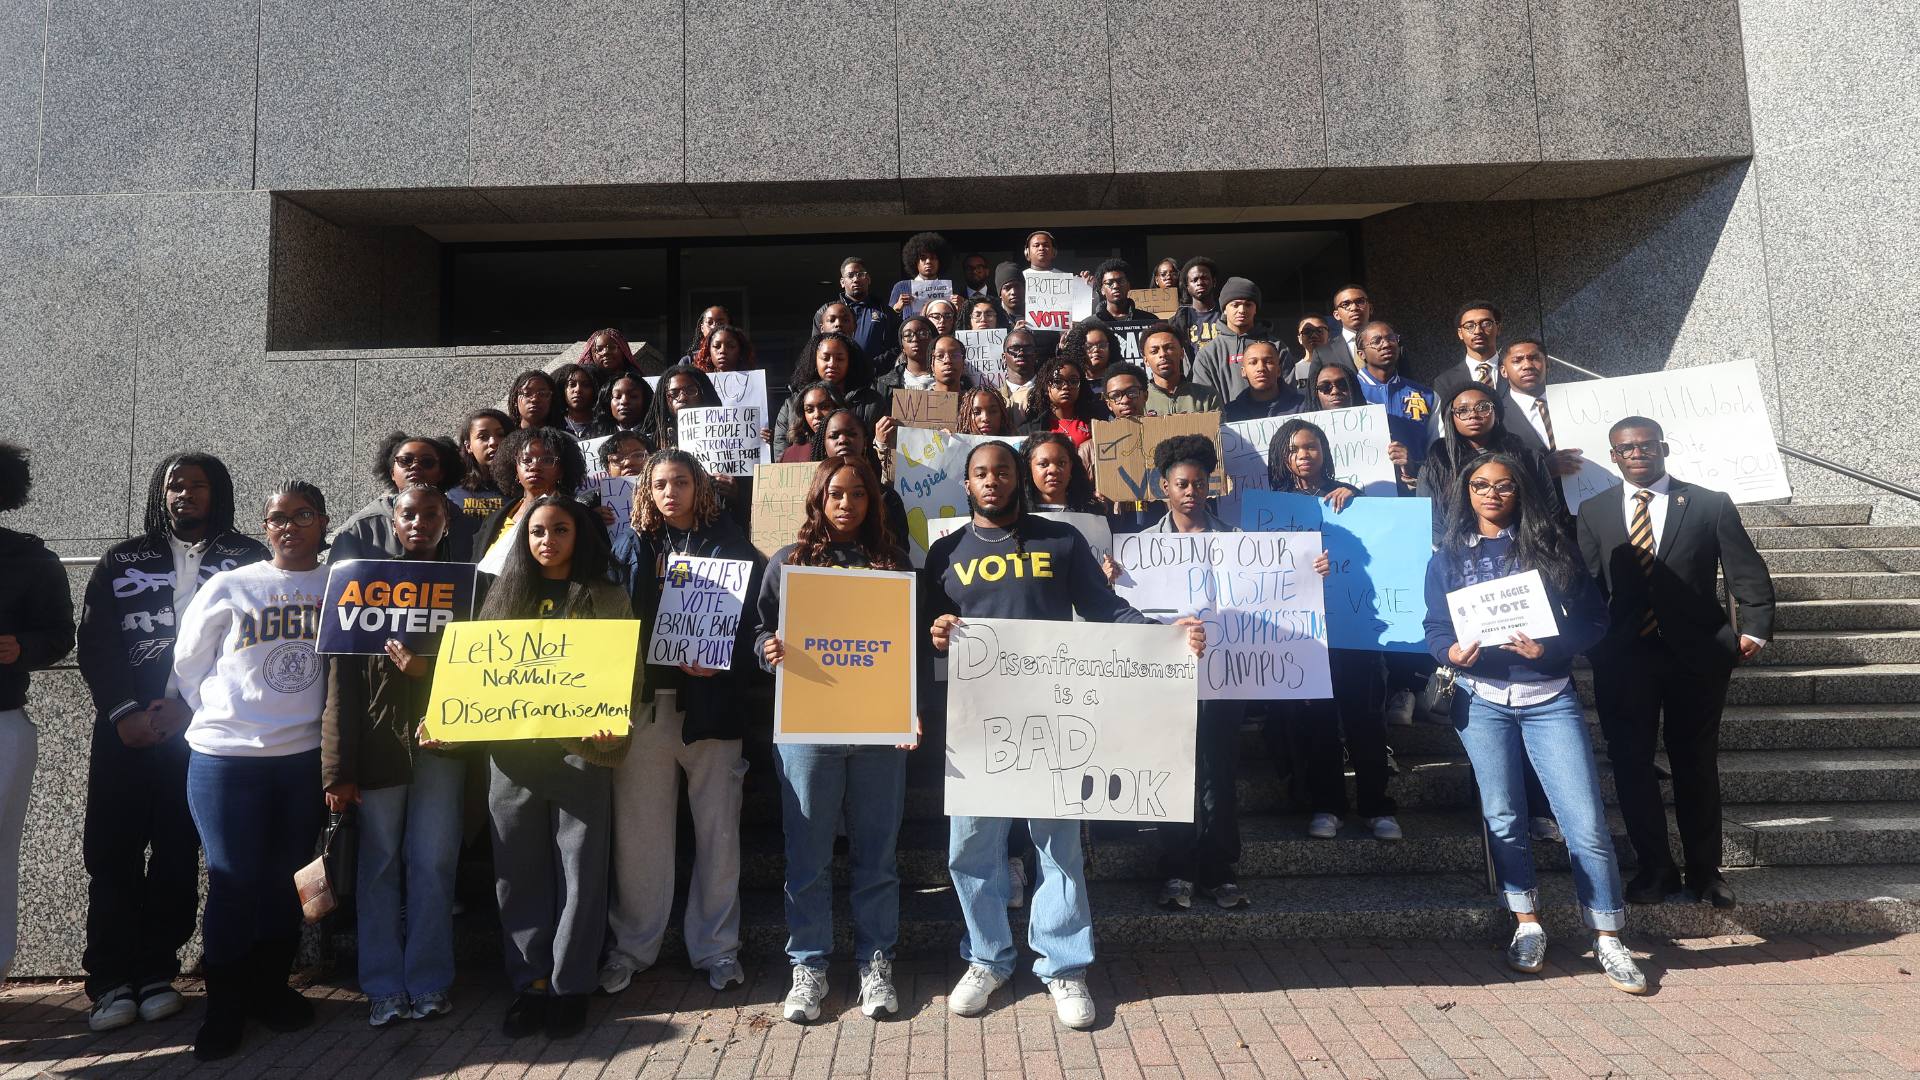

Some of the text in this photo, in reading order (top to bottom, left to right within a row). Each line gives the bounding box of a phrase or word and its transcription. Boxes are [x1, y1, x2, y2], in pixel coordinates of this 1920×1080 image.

[1026, 276, 1073, 295] PROTECT
[1029, 311, 1070, 329] VOTE
[964, 346, 989, 361] OTE
[680, 408, 758, 426] THE POWER OF
[1330, 408, 1374, 435] FOR
[681, 423, 757, 441] THE PEOPLE IS
[696, 438, 745, 453] STRONGER
[715, 450, 735, 461] THE
[902, 431, 945, 468] Let
[709, 461, 749, 474] POWER
[900, 468, 947, 499] Aggies
[463, 497, 502, 510] NORTH
[1120, 535, 1225, 572] CLOSING
[1237, 535, 1296, 569] OUR
[953, 551, 1054, 586] VOTE
[337, 580, 455, 609] AGGIE
[681, 590, 729, 614] VOTE
[1347, 588, 1413, 614] VOTE
[1480, 584, 1531, 603] LET AGGIES
[1487, 599, 1530, 616] VOTE
[233, 604, 323, 653] AGGI
[656, 612, 739, 638] BRING BACK
[448, 629, 574, 664] Let's Not
[653, 638, 689, 665] OUR
[803, 637, 892, 654] PROTECT
[957, 623, 1196, 681] Disenfranchisement
[820, 653, 875, 668] OURS
[1207, 649, 1304, 691] CAMPUS
[1053, 683, 1100, 706] is a
[983, 714, 1097, 775] BAD
[1051, 765, 1172, 818] LOOK
